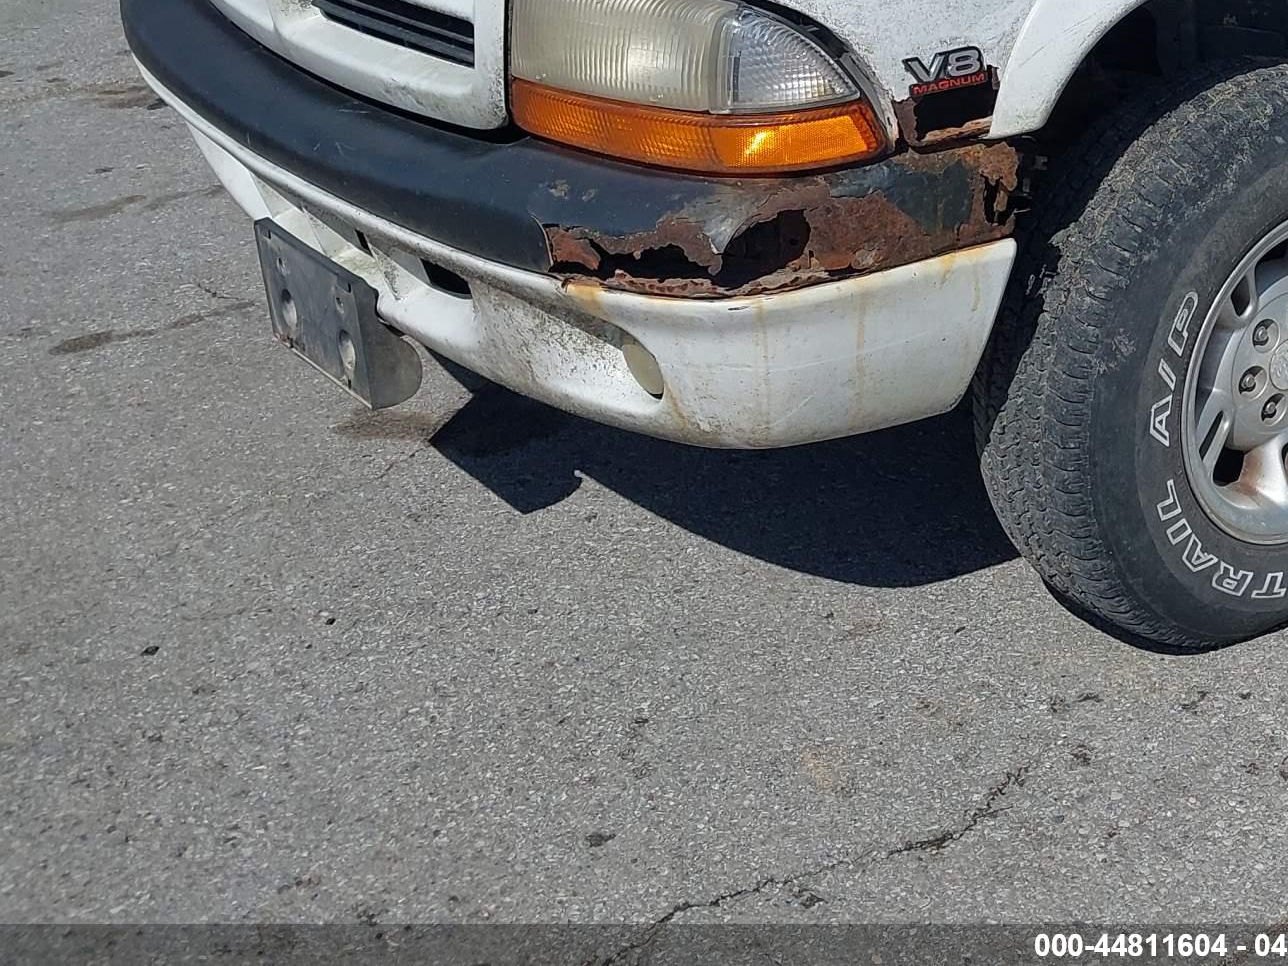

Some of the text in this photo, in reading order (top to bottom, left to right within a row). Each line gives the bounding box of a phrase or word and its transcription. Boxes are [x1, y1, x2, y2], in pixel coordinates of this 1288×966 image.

[902, 46, 984, 84] V8
[912, 72, 986, 95] MAGNUM
[1157, 479, 1287, 599] TRAIL
